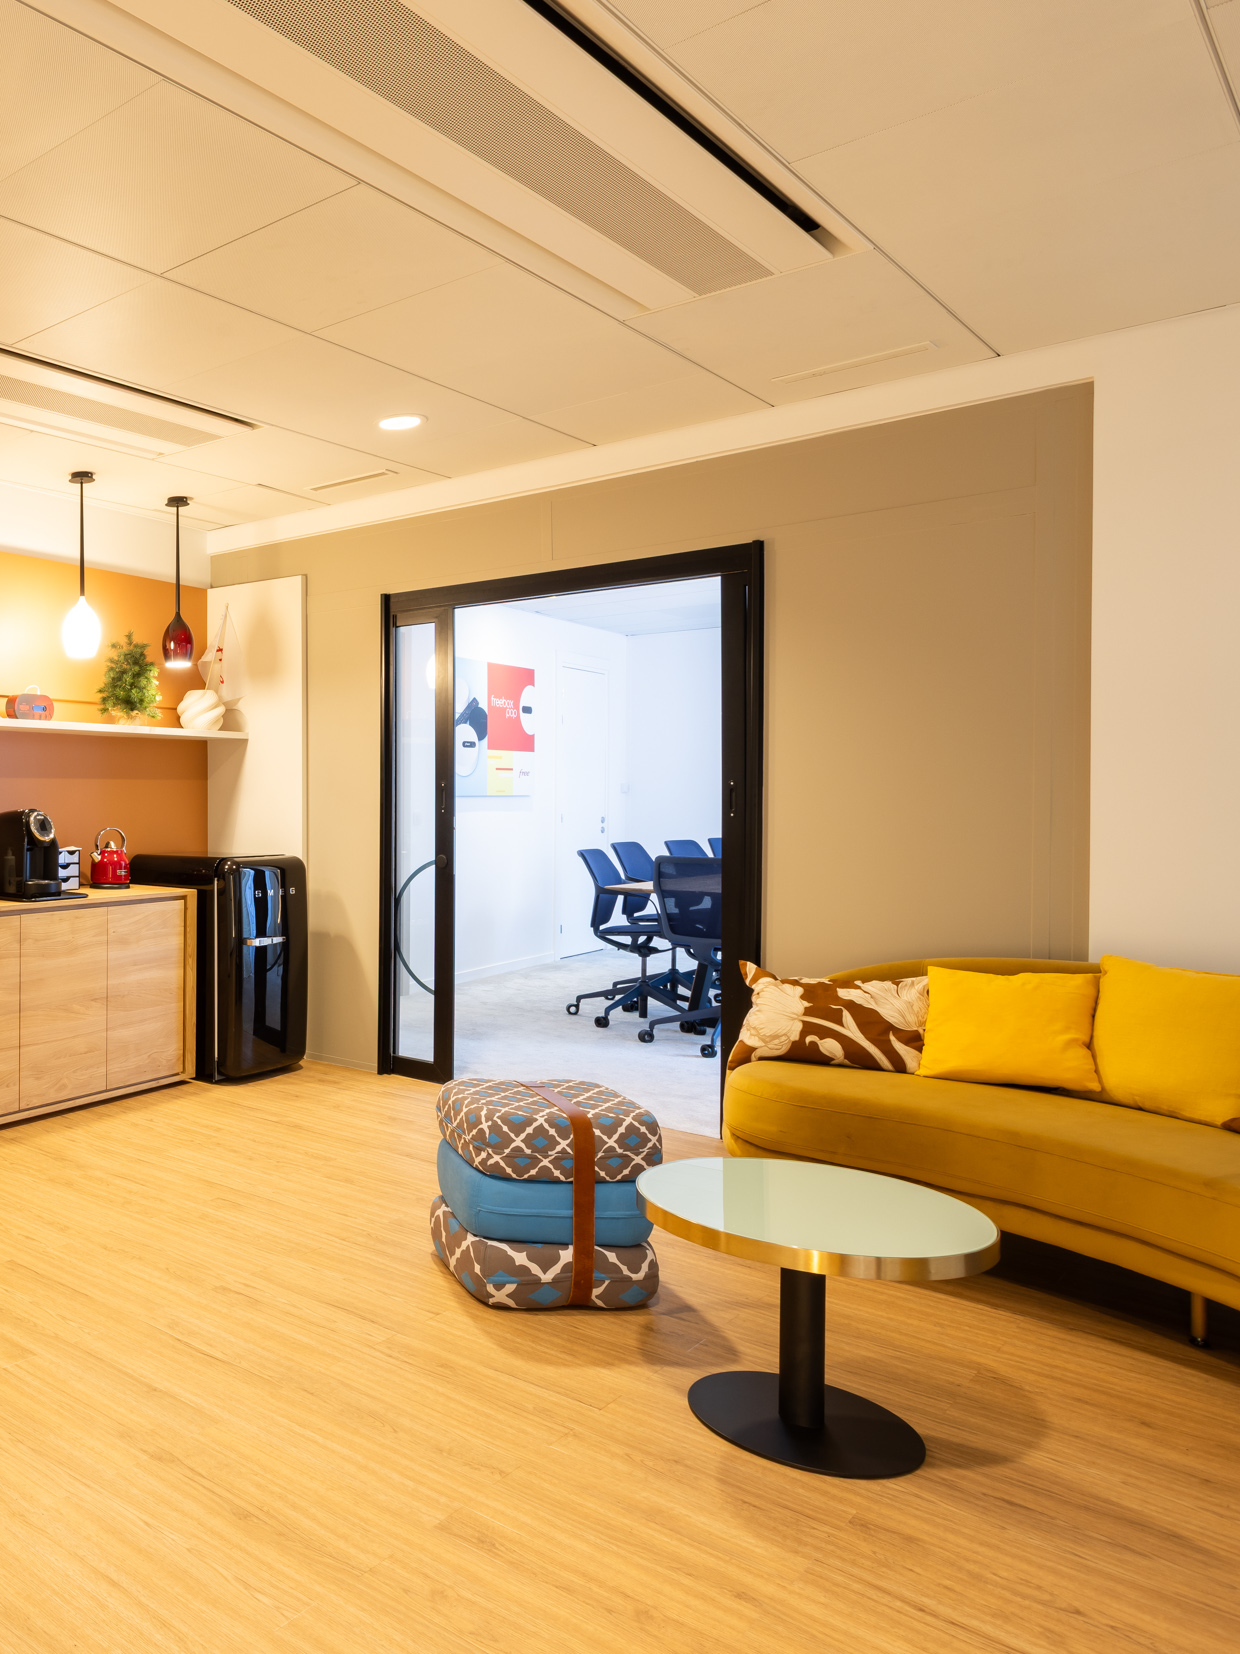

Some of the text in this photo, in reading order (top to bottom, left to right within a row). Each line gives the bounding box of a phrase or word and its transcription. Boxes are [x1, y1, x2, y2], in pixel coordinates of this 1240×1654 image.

[491, 695, 513, 708] freebox
[506, 708, 517, 719] pop
[255, 887, 296, 898] SMEG
